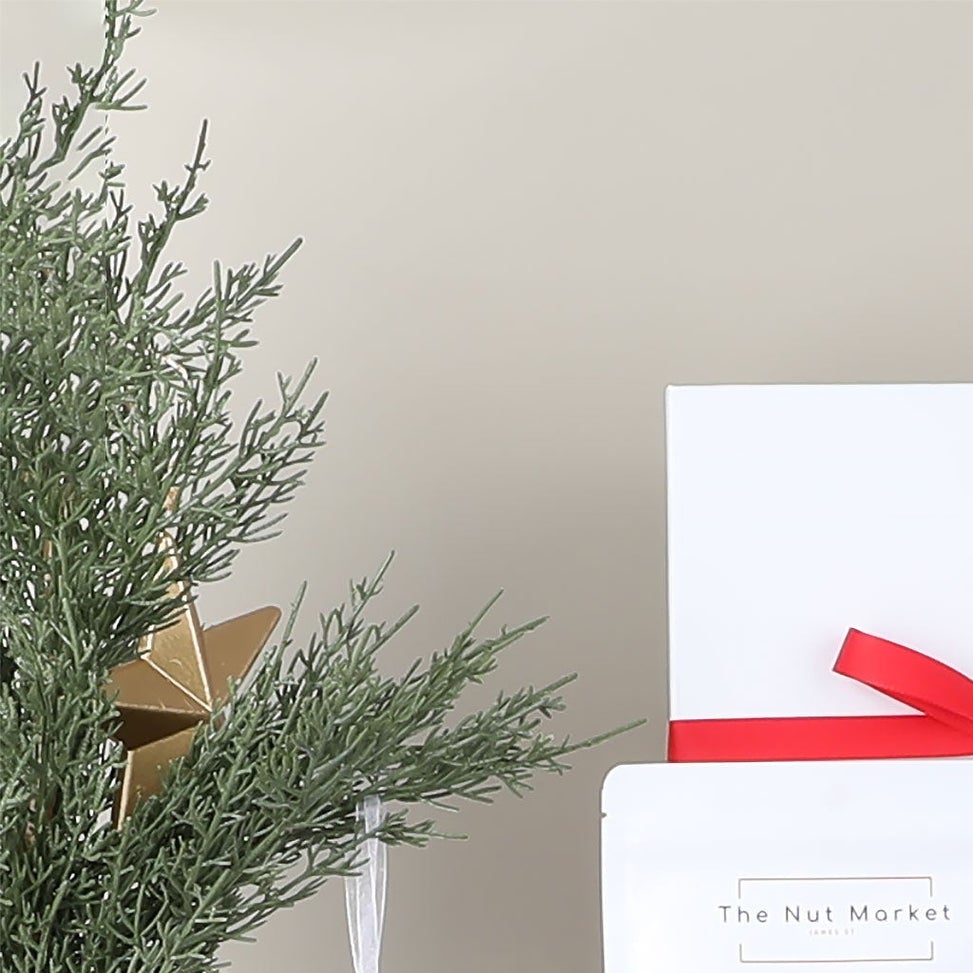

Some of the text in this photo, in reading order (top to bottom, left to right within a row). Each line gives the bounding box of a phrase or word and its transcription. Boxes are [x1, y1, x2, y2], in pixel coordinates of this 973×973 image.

[718, 903, 951, 923] The Nut Market
